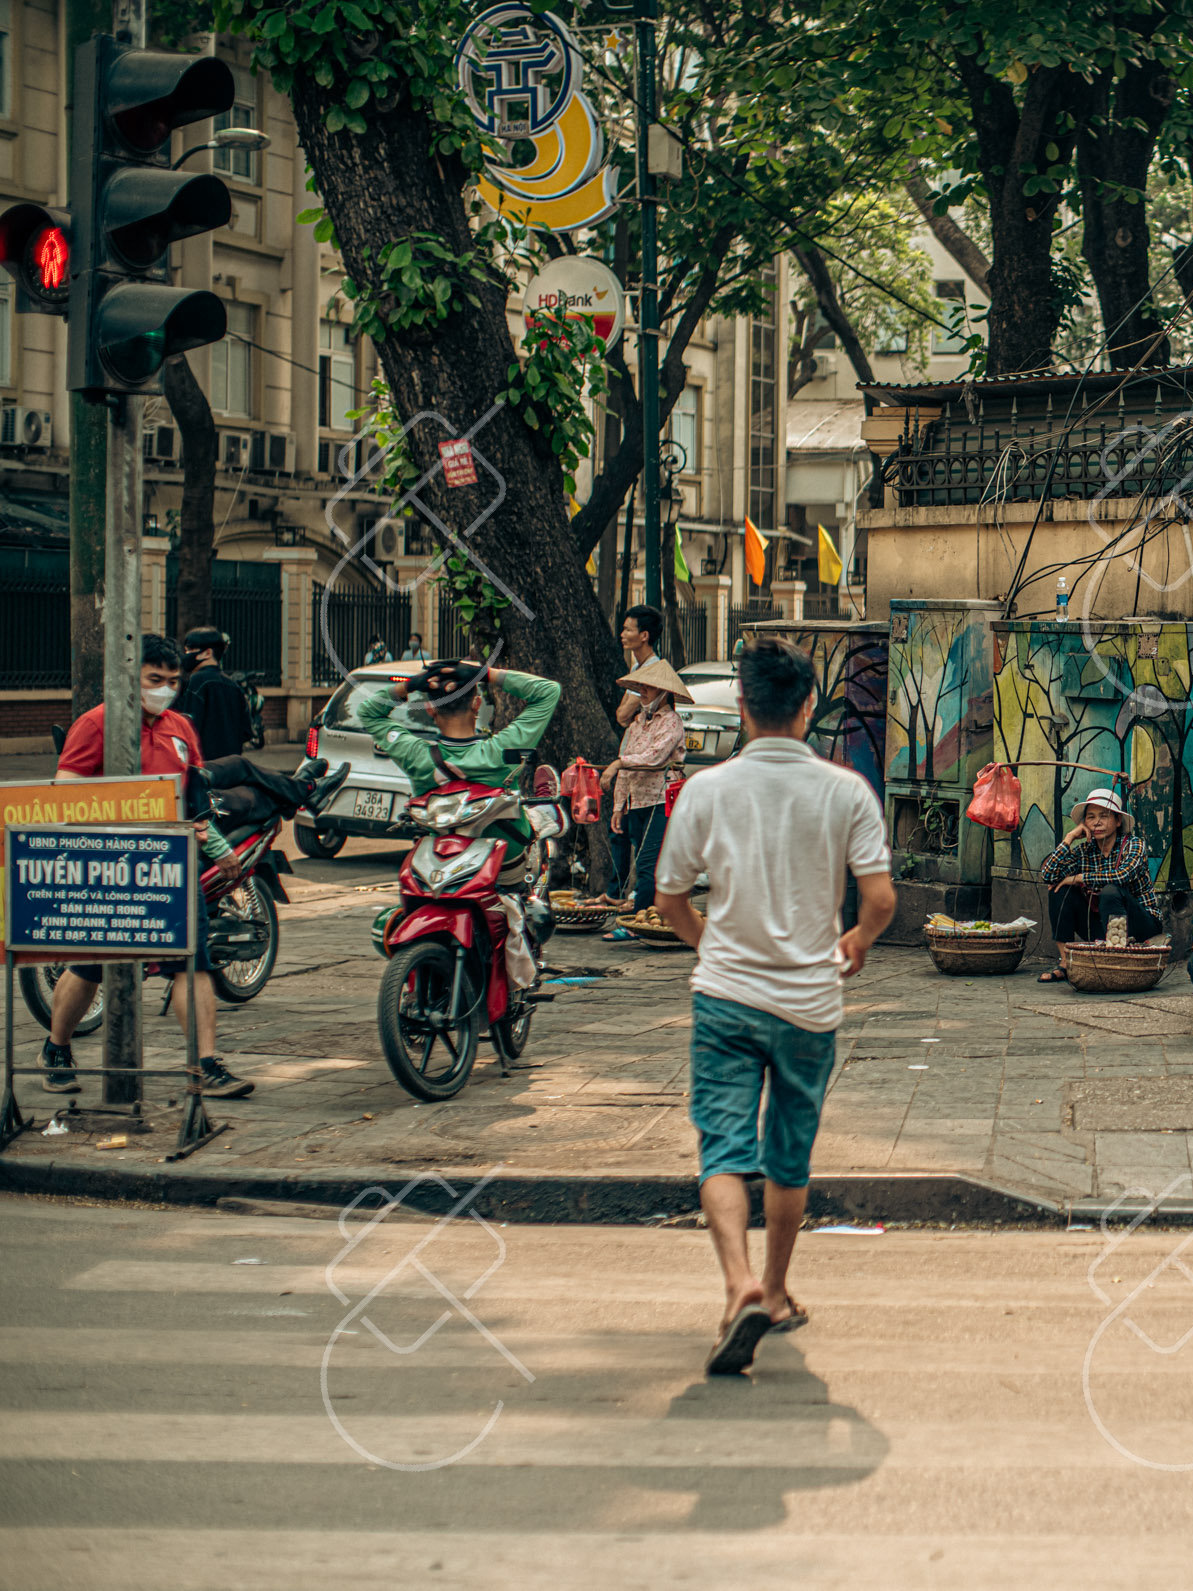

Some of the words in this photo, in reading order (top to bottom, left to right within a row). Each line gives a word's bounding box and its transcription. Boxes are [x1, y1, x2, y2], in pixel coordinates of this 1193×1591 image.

[365, 791, 383, 805] 36A
[63, 796, 115, 822] HOÀN
[121, 789, 165, 820] KIẾM
[29, 837, 57, 848] UBND
[59, 835, 103, 849] PHƯỜNG
[105, 836, 136, 850] HÀNG
[138, 837, 169, 850] BÔNG
[16, 853, 82, 885] TUYẾN
[88, 853, 130, 886] PHỐ
[135, 854, 182, 888] CẤM
[27, 888, 52, 900] (TRÊN
[54, 889, 66, 899] HÈ
[67, 888, 88, 900] PHỐ
[89, 890, 103, 900] VÀ
[104, 890, 131, 901] LÒNG
[60, 902, 83, 914] BÁN
[85, 902, 114, 915] HÀNG
[116, 905, 147, 915] RONG
[41, 916, 67, 927] KINH
[69, 917, 108, 929] DOANH,
[111, 917, 140, 929] BUÔN
[142, 917, 165, 930] BÁN
[32, 926, 46, 940] ĐỂ
[49, 930, 62, 940] XE
[64, 930, 87, 943] ĐẠP,
[90, 931, 104, 941] XE
[106, 930, 131, 943] MÁY,
[134, 932, 147, 942] XE
[149, 930, 158, 943] Ô
[160, 931, 174, 943] TÔ
